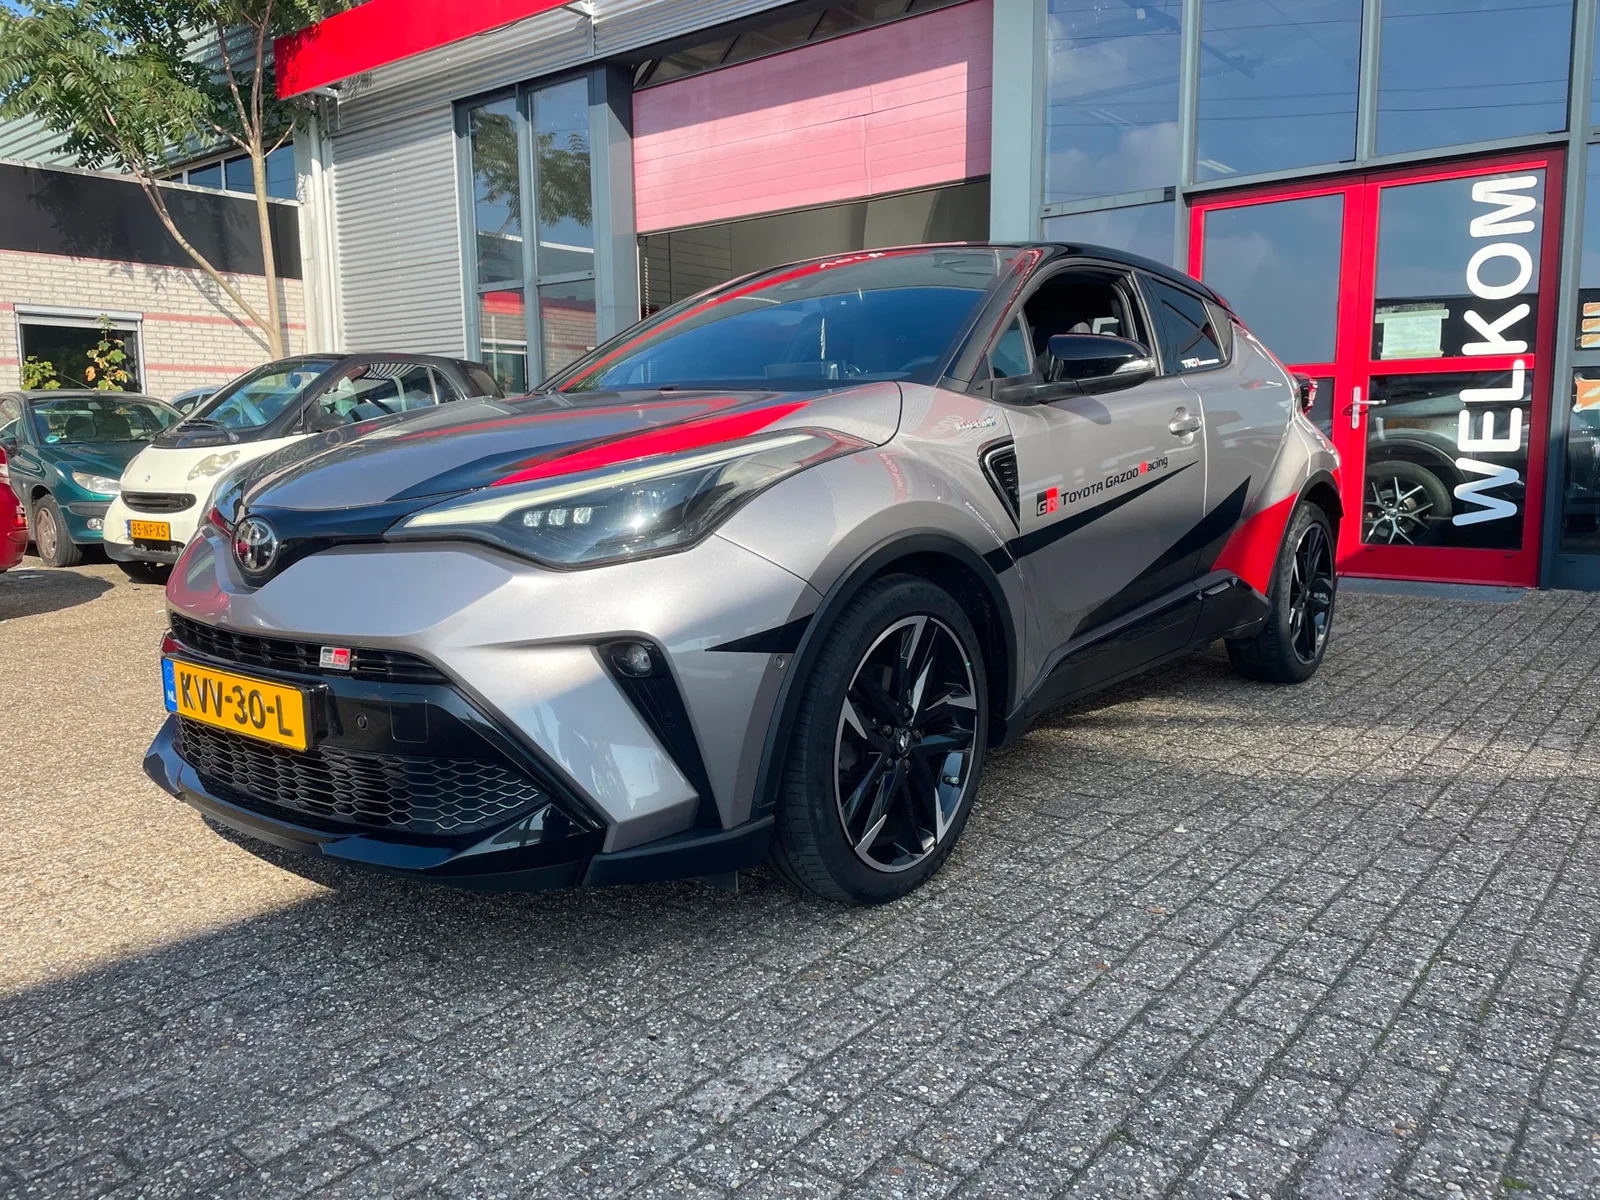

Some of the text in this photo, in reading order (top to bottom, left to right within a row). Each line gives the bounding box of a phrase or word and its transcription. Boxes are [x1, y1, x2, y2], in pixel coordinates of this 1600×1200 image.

[1452, 175, 1538, 526] WELKOM
[1037, 456, 1168, 517] GR TOYOTA GAZOO Racing
[132, 522, 166, 538] 85-NF-XS
[167, 689, 177, 703] NL
[180, 670, 294, 737] KVV-30-L
